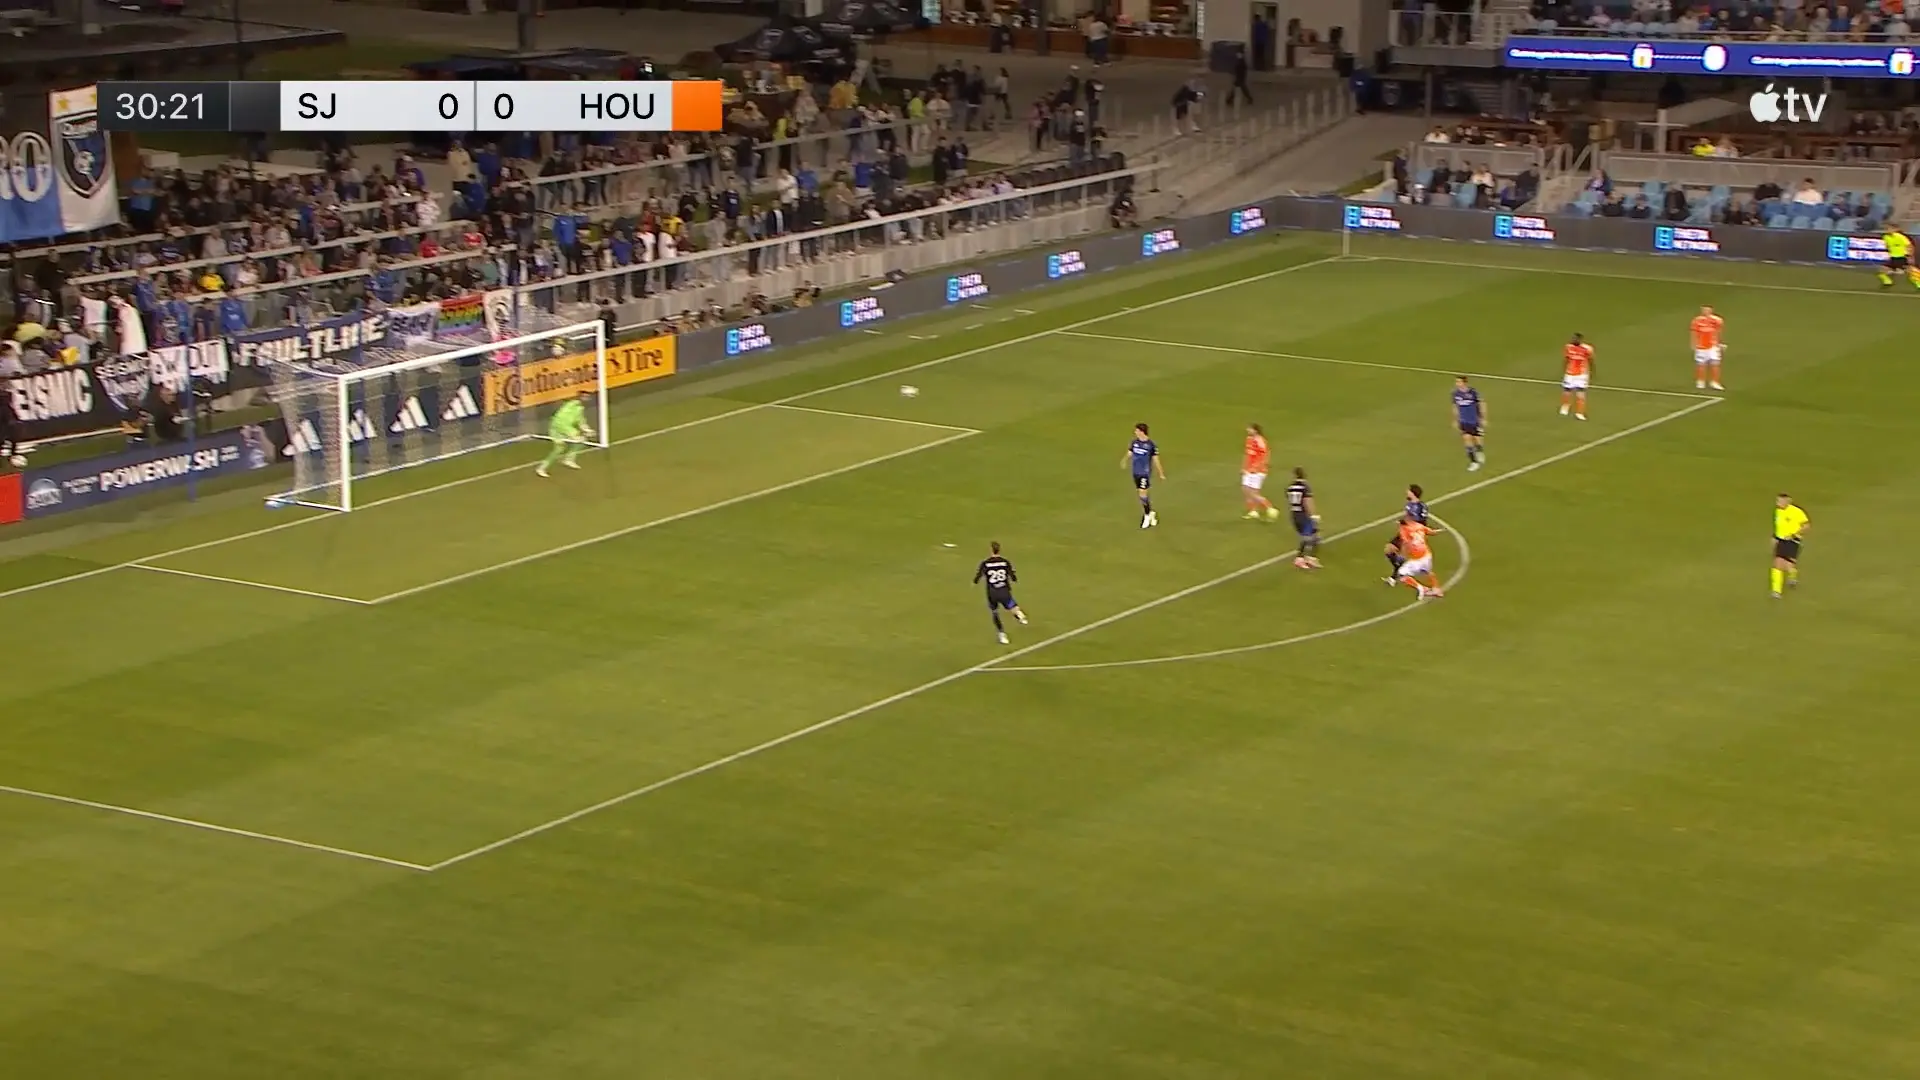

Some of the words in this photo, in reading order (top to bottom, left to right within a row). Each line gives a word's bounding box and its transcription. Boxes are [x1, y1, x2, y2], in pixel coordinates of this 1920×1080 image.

[503, 361, 606, 406] Continenta
[622, 347, 663, 373] Tire
[99, 450, 219, 491] POWERWSH
[987, 569, 1007, 584] 28
